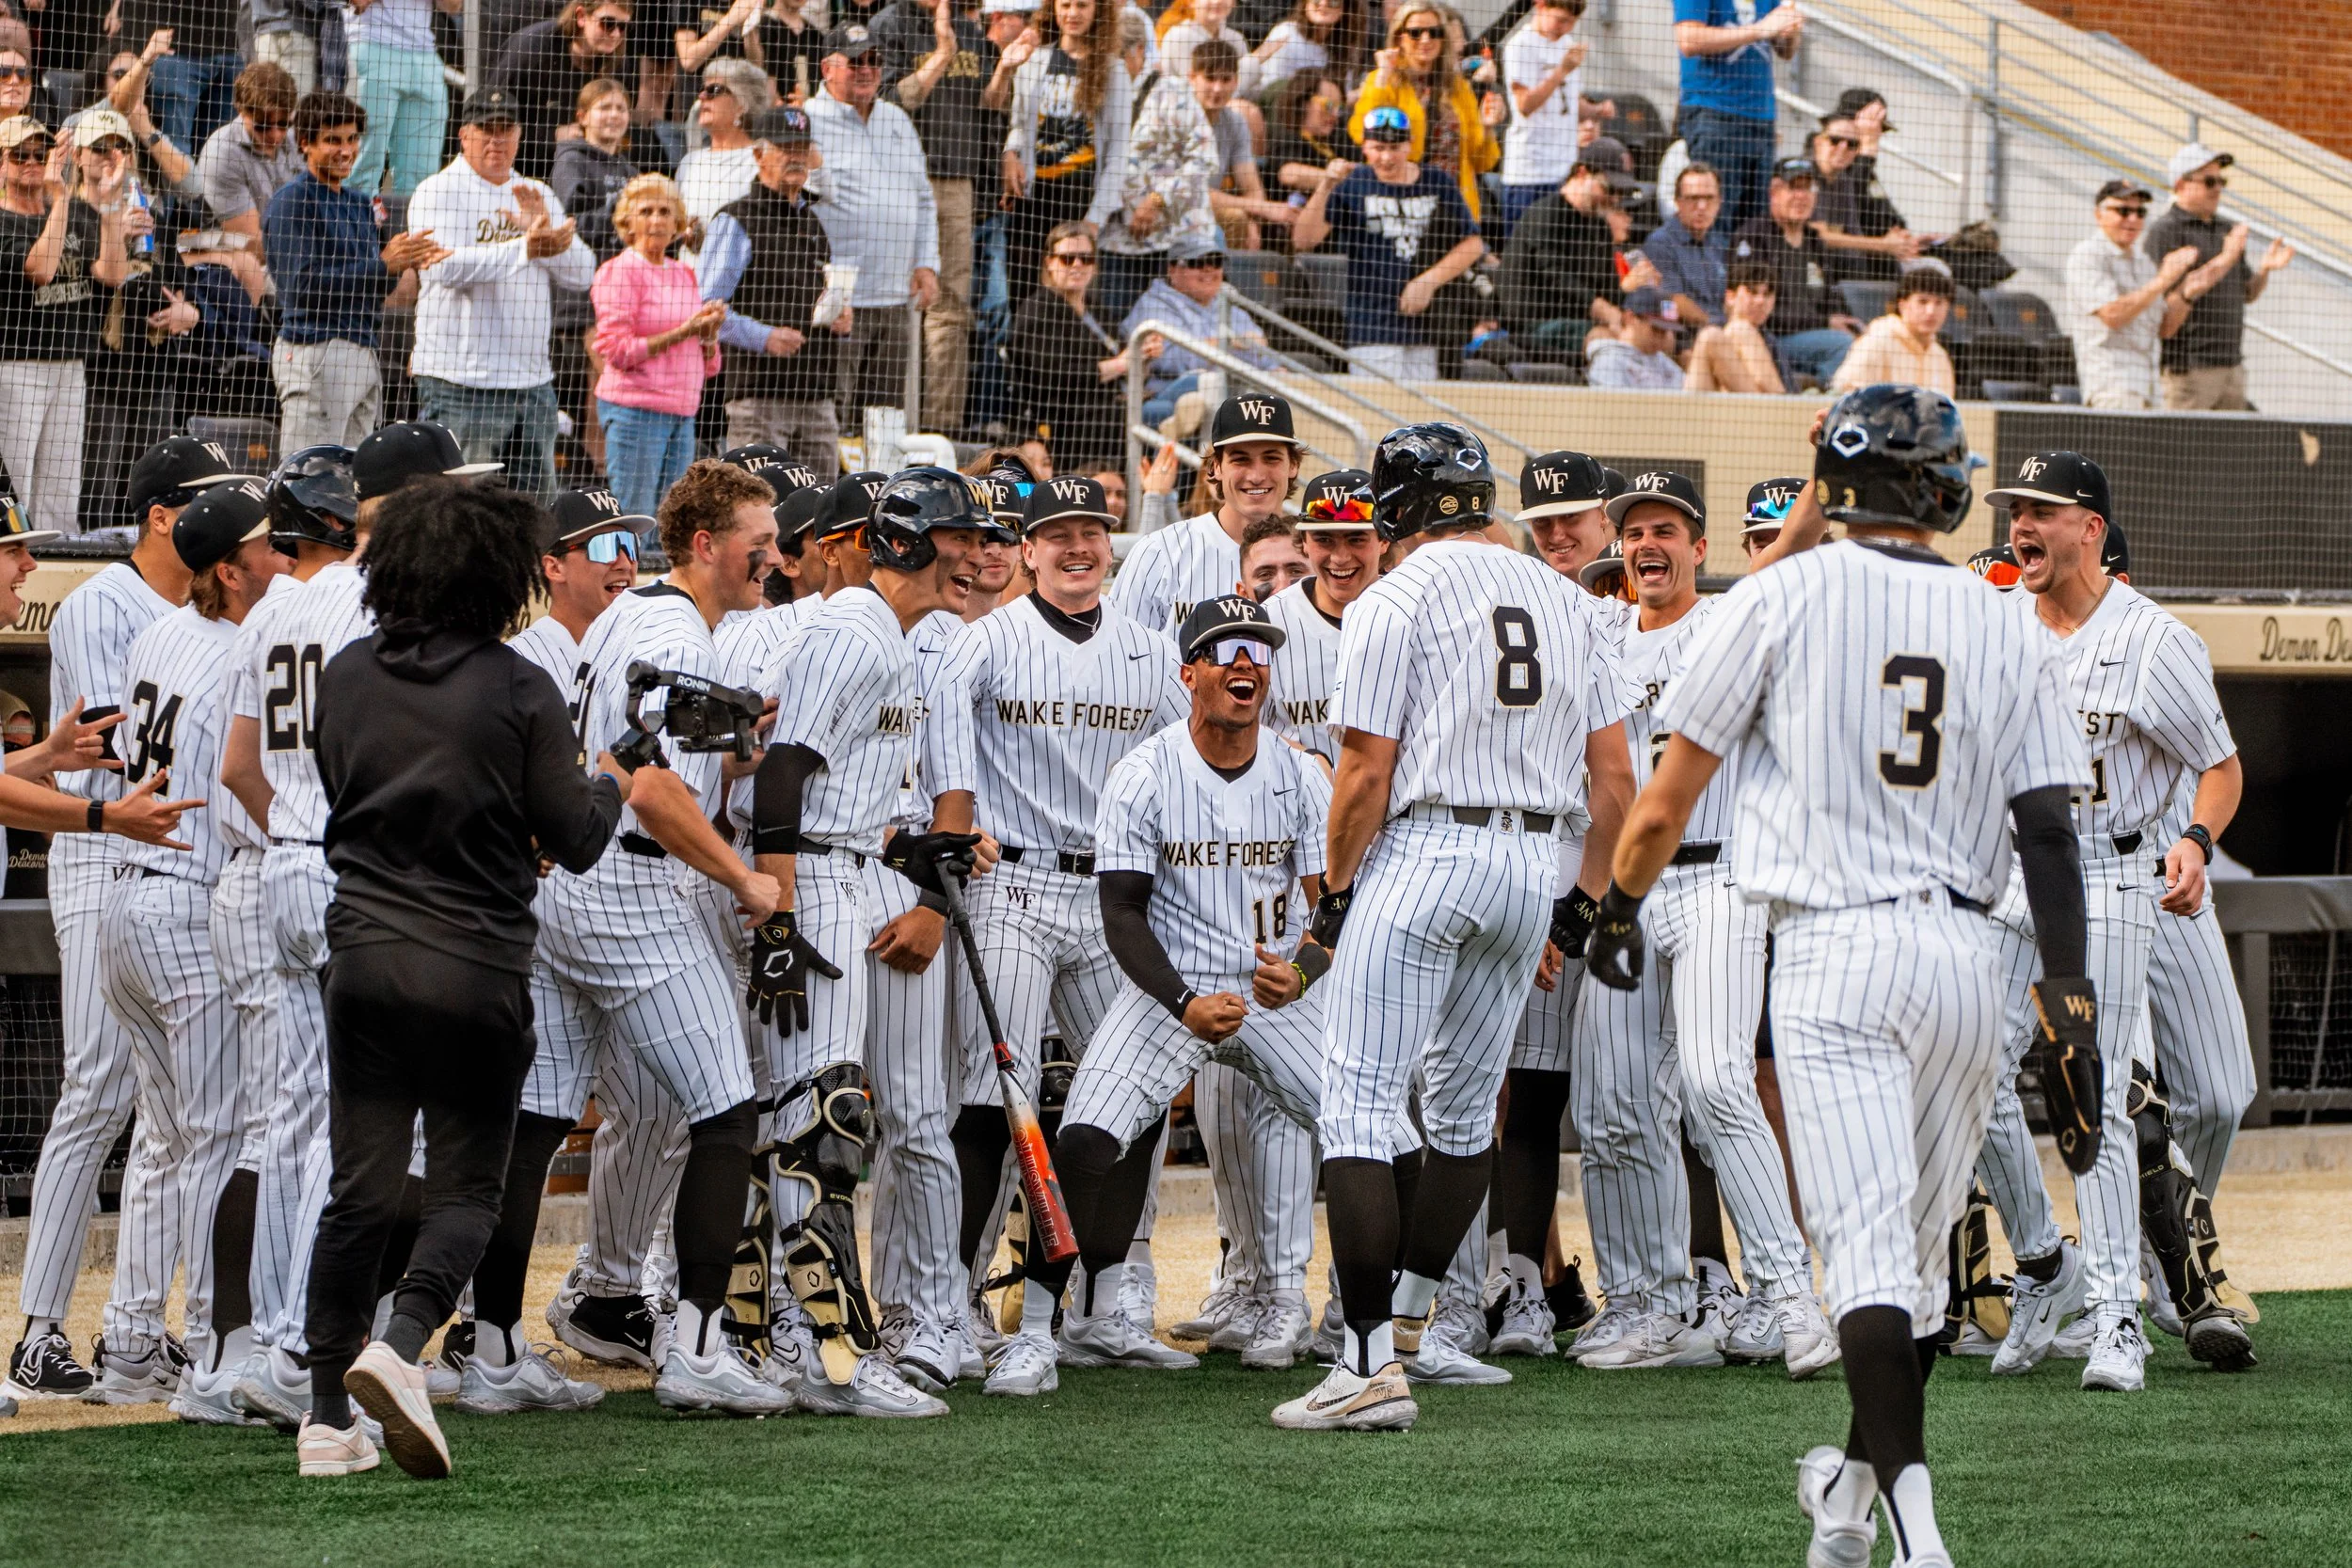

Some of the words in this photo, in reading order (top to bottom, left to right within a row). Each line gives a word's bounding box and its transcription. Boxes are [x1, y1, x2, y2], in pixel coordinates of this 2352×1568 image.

[1238, 400, 1276, 425] WF
[1533, 467, 1568, 495] WF
[2019, 456, 2047, 482] WF
[1050, 480, 1089, 504] WF
[1635, 472, 1670, 493] WF
[585, 491, 621, 516] WF
[1472, 497, 1479, 510] 8
[1843, 487, 1856, 507] 3
[1217, 599, 1255, 622] WF
[2260, 616, 2319, 661] Demon
[1491, 605, 1543, 707] 8
[676, 674, 711, 693] RONIN
[264, 642, 325, 752] 20
[878, 705, 913, 735] WAK
[995, 699, 1064, 725] WAKE
[1073, 703, 1152, 731] FOREST
[1284, 699, 1330, 725] WAK
[1877, 653, 1947, 790] 3
[126, 677, 186, 798] 34
[8, 856, 46, 868] Deacons
[1161, 841, 1219, 866] WAKE
[1226, 840, 1295, 866] FOREST
[1006, 886, 1036, 910] WF
[1253, 893, 1287, 944] 18
[2064, 995, 2096, 1022] WF
